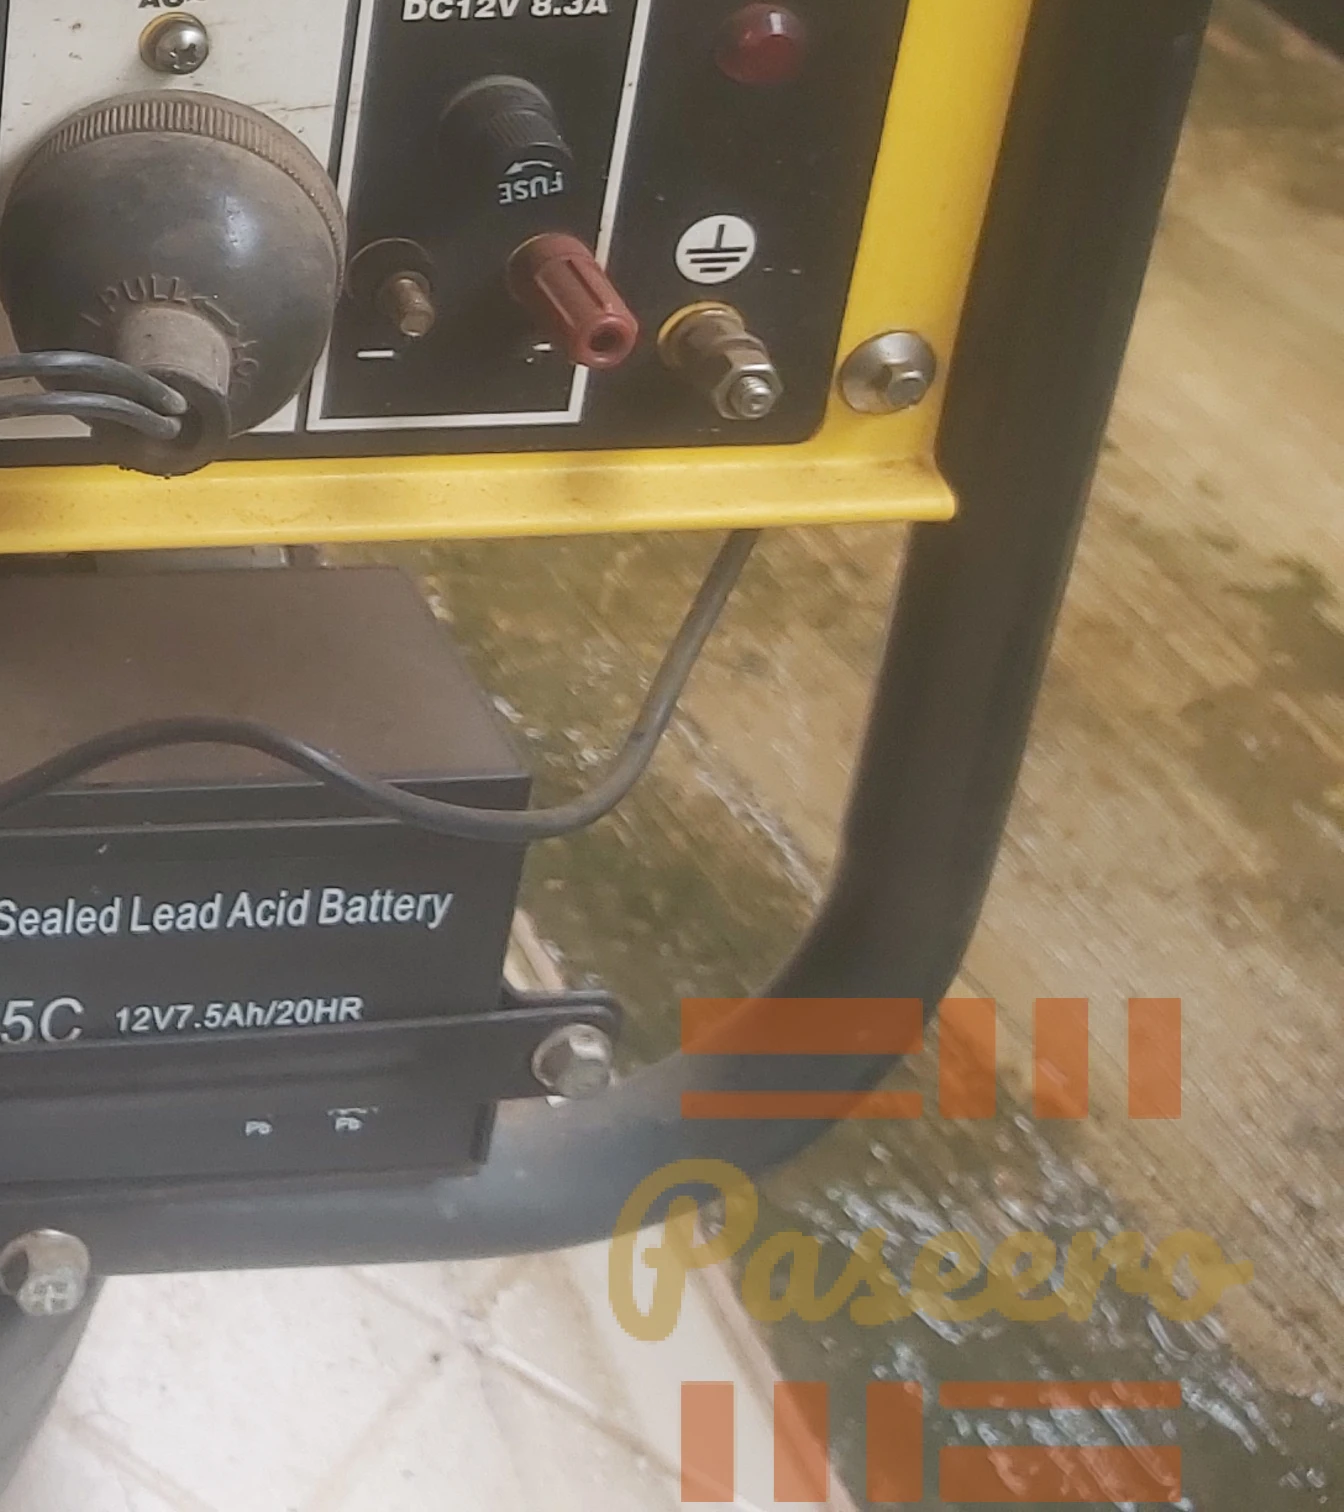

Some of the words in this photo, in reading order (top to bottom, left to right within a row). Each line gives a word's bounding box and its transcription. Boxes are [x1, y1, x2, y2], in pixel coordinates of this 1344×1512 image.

[498, 171, 564, 205] FUSE
[130, 892, 222, 933] Lead
[228, 890, 310, 929] Acid
[318, 887, 454, 931] Battery
[114, 995, 364, 1034] 12V7.5Ah/20HR
